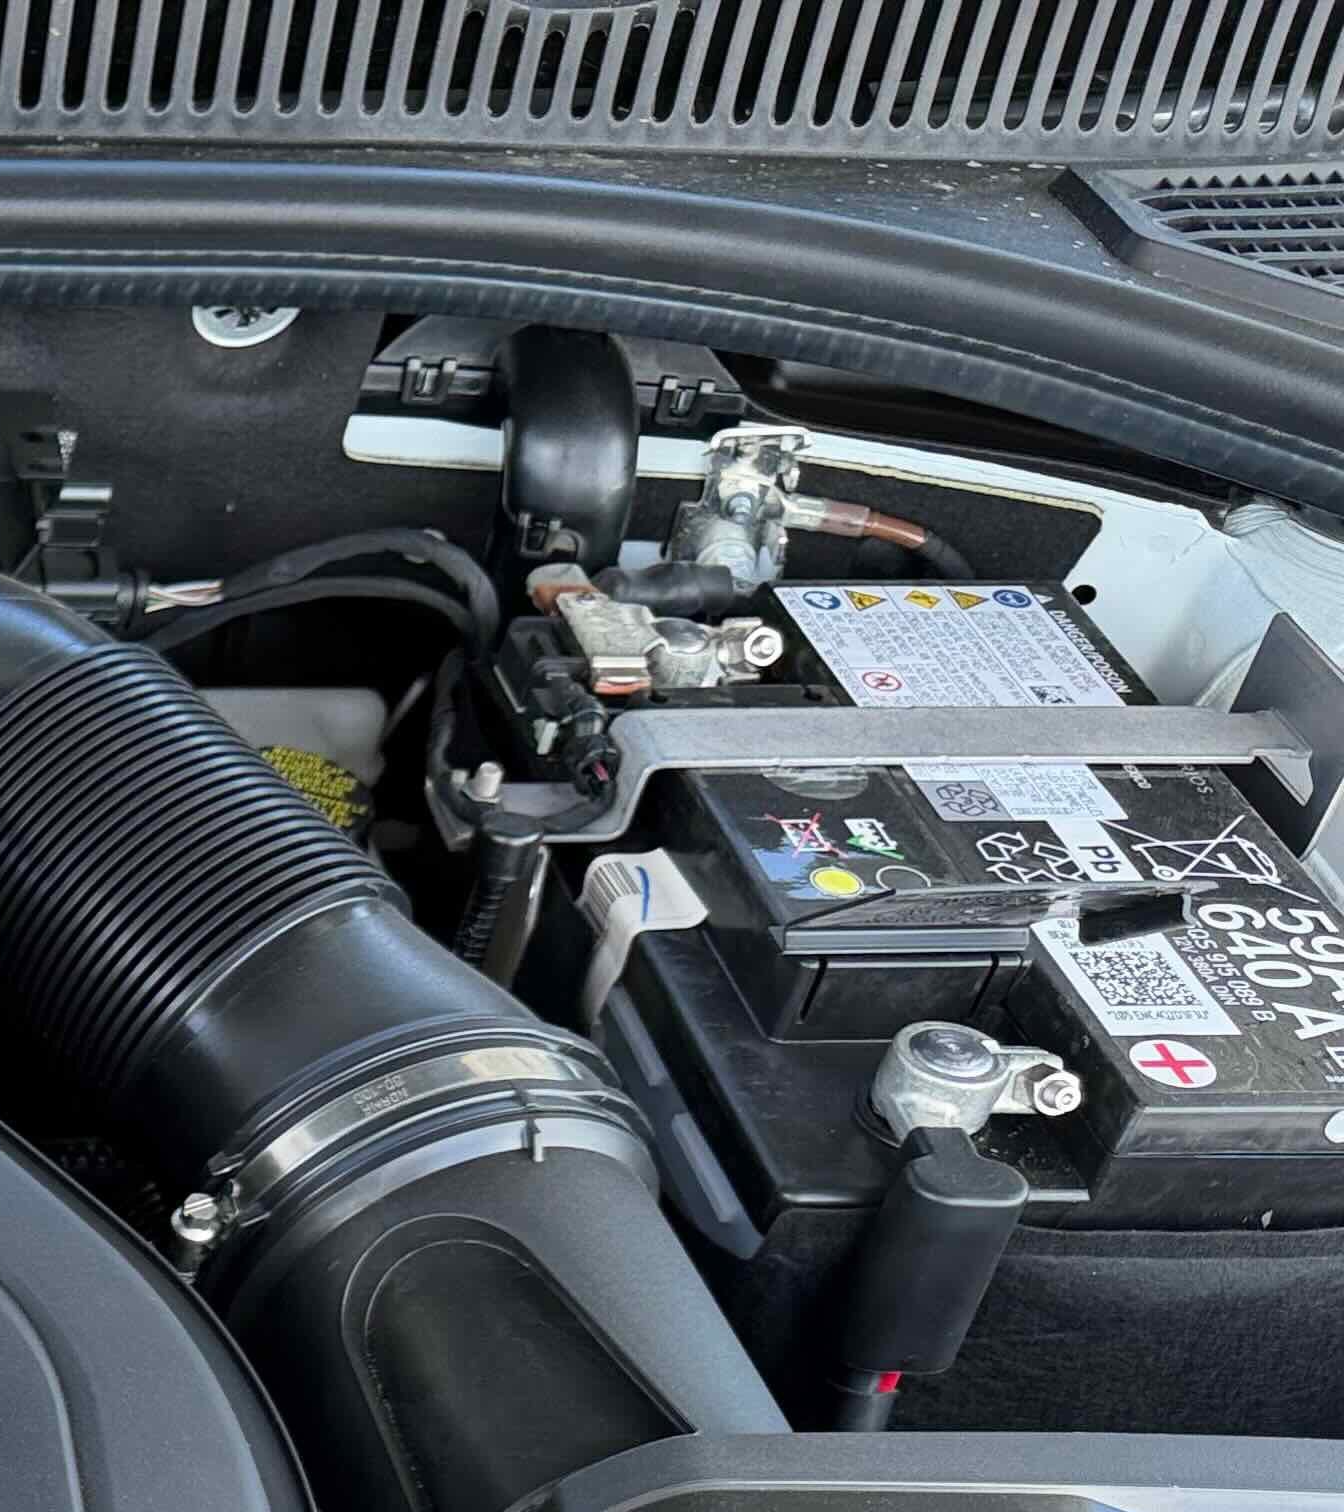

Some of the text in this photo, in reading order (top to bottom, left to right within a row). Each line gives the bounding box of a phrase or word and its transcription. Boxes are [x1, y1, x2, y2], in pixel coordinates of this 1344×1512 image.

[1049, 609, 1133, 694] DANGER/POISON
[1078, 845, 1120, 875] Pb
[1188, 955, 1219, 984] 380A
[1211, 985, 1241, 1006] DIN
[1197, 903, 1314, 989] 640
[1206, 953, 1242, 977] 915
[1227, 980, 1265, 1007] 089
[1250, 1010, 1278, 1022] B
